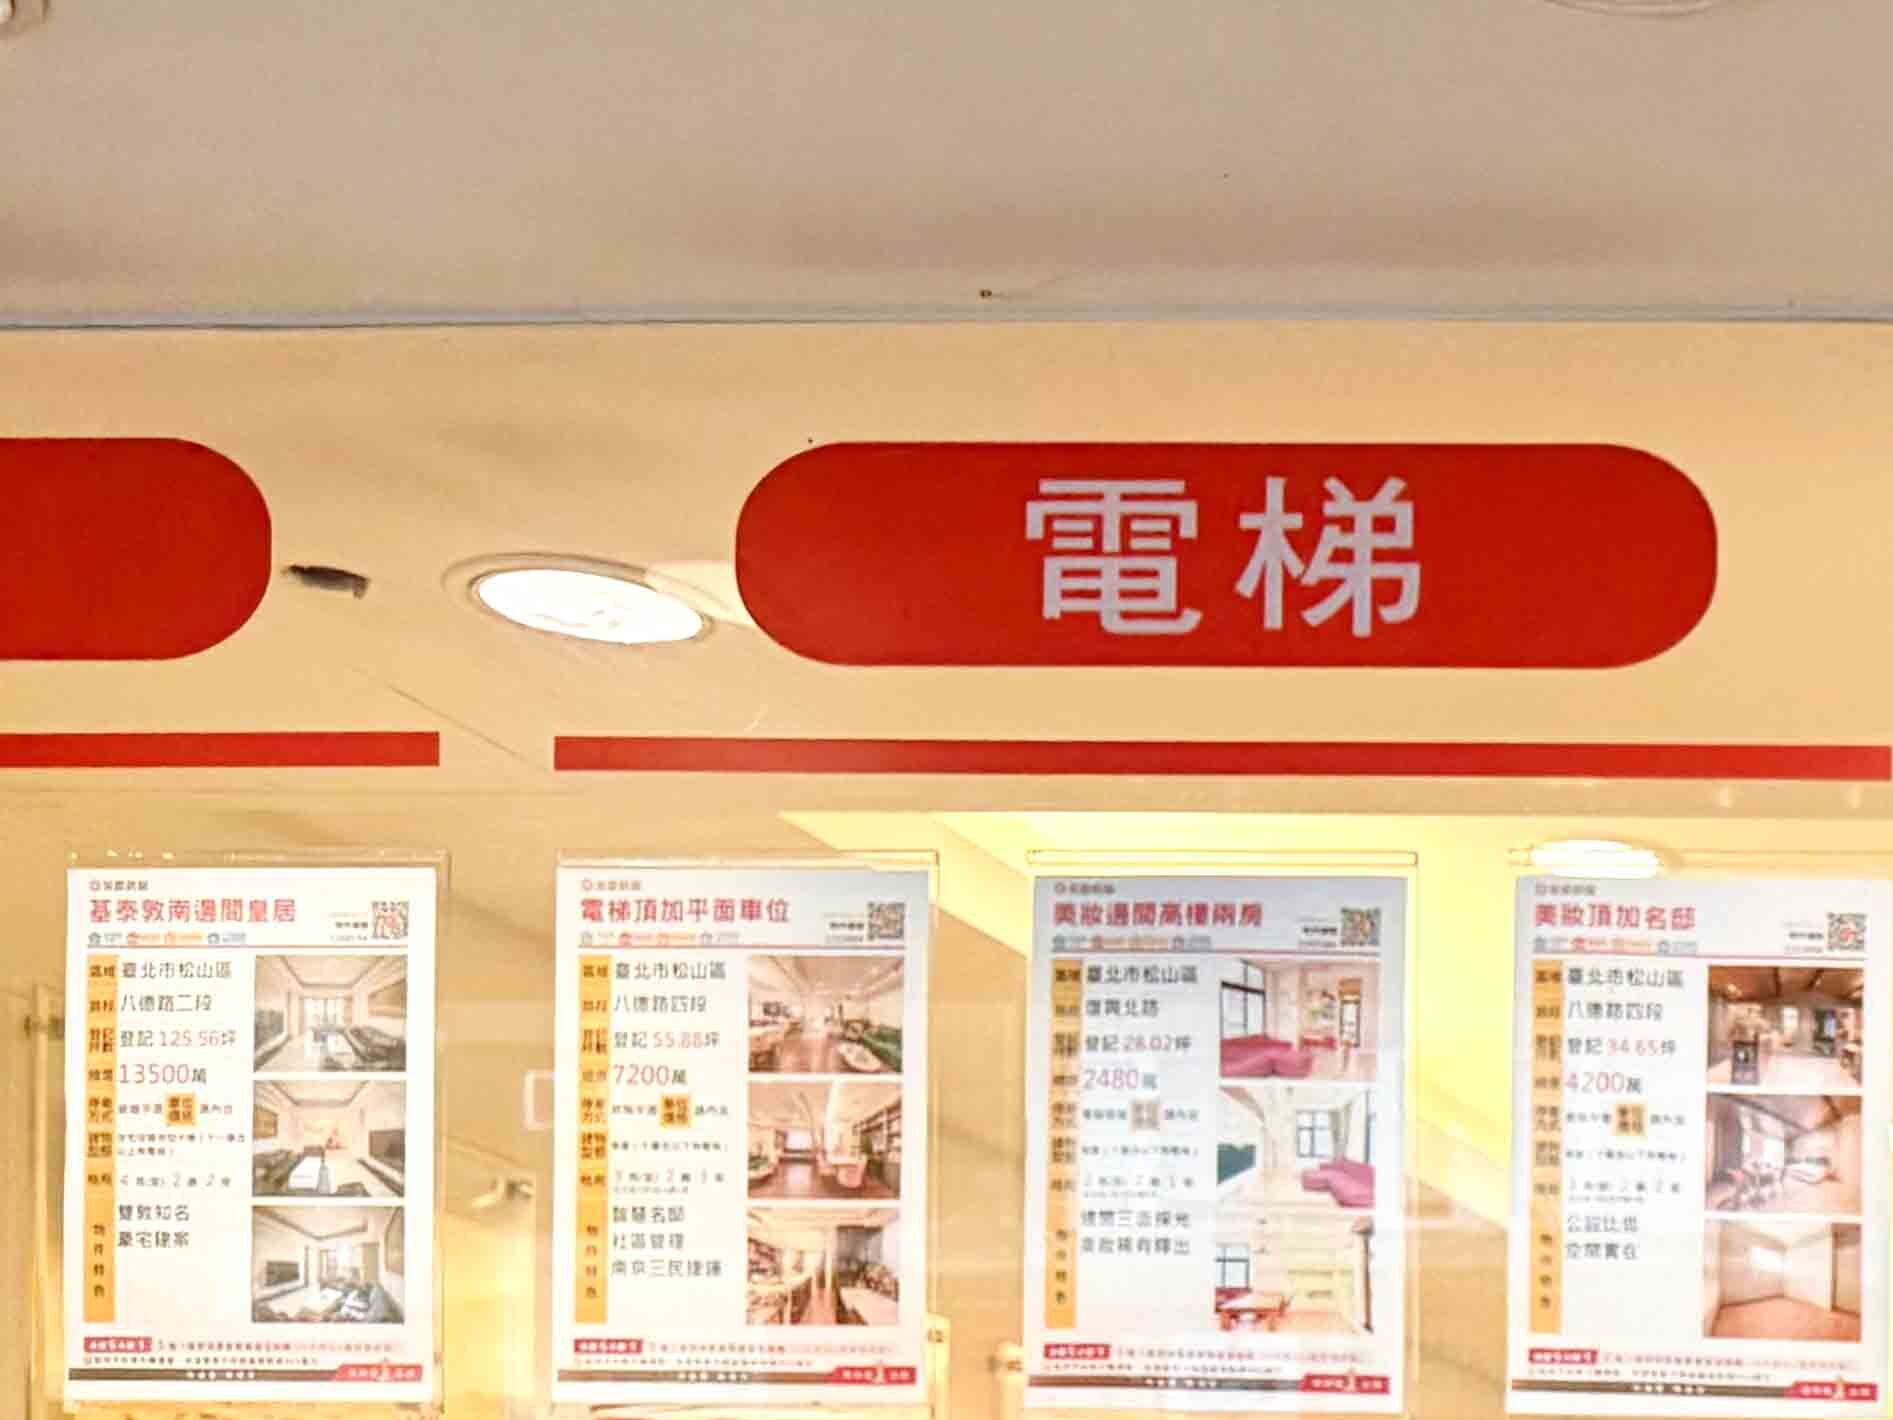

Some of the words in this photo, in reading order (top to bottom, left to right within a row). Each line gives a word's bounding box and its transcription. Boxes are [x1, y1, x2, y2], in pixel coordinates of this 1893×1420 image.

[1023, 478, 1421, 637] 電梯
[581, 898, 790, 923] 電梯頂加平面車位
[121, 994, 212, 1013] 八德路二段
[613, 995, 707, 1013] 八德路四段
[119, 1064, 207, 1085] 13500萬
[614, 1065, 687, 1086] 7200萬
[1565, 1072, 1643, 1094] 4200萬
